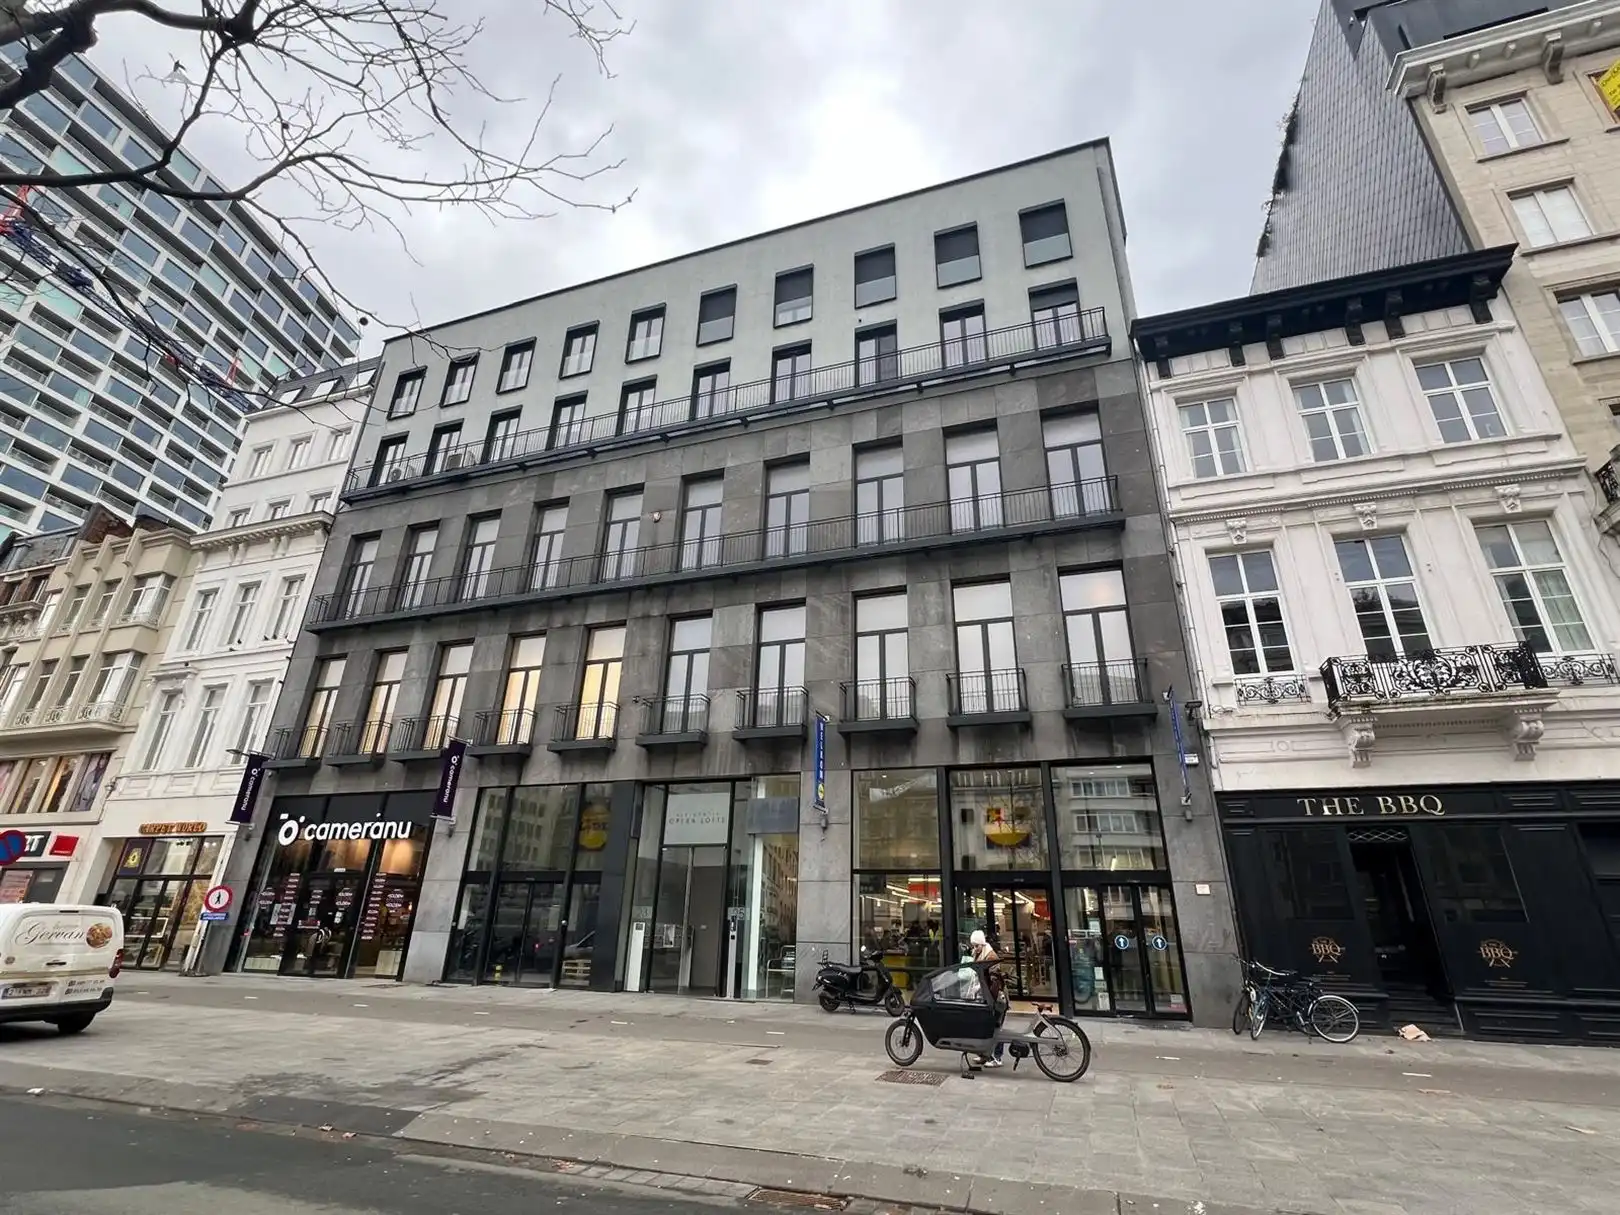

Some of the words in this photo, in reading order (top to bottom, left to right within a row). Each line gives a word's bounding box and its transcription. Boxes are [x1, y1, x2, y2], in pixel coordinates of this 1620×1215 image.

[240, 776, 256, 811] cameranu
[443, 765, 456, 803] cameranu
[1296, 796, 1365, 816] THE
[1376, 794, 1446, 816] BBQ
[304, 813, 413, 841] cameranu
[1311, 943, 1341, 956] BBQ
[1479, 946, 1514, 960] BBQ
